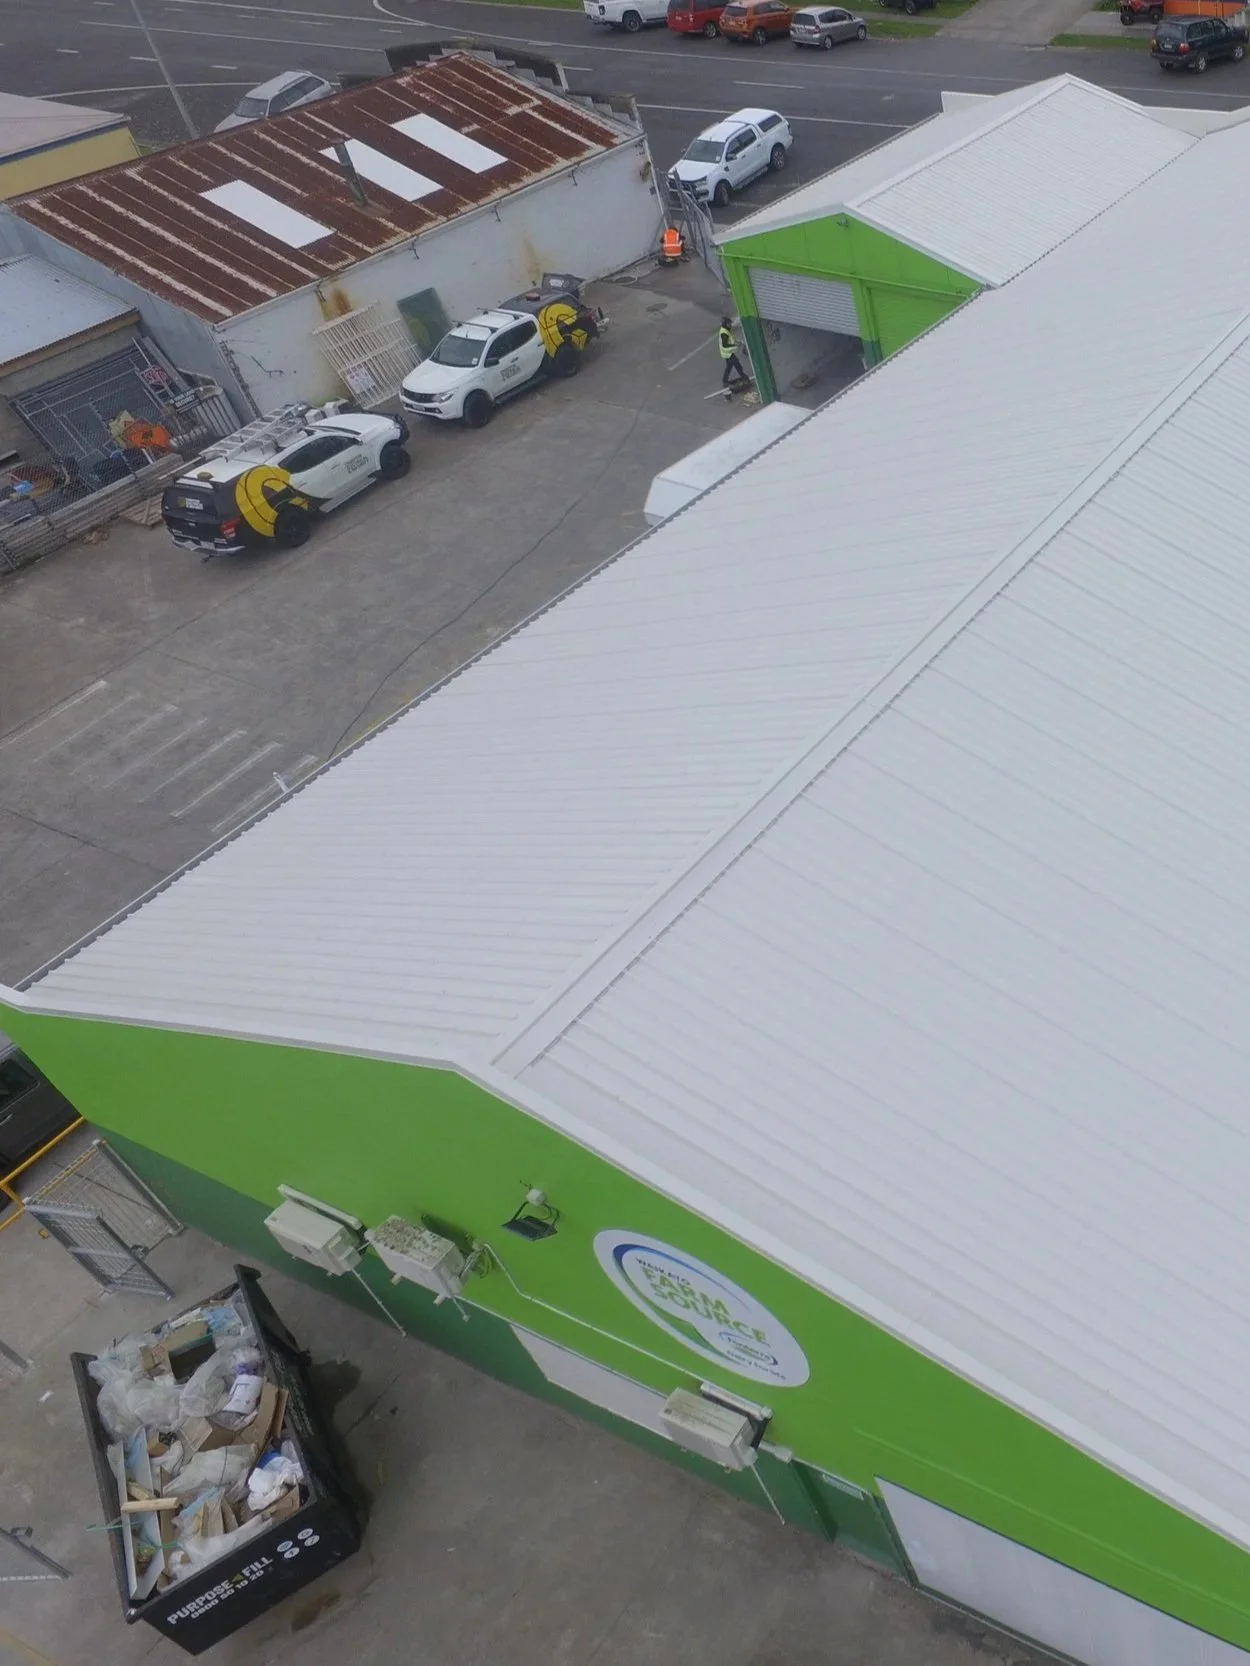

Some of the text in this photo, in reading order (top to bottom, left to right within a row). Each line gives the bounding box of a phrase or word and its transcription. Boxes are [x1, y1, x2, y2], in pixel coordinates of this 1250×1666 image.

[641, 1266, 730, 1318] FARM
[650, 1282, 771, 1349] SOURCE
[167, 1556, 273, 1625] PURPOSE FILL
[190, 1599, 219, 1619] 0800
